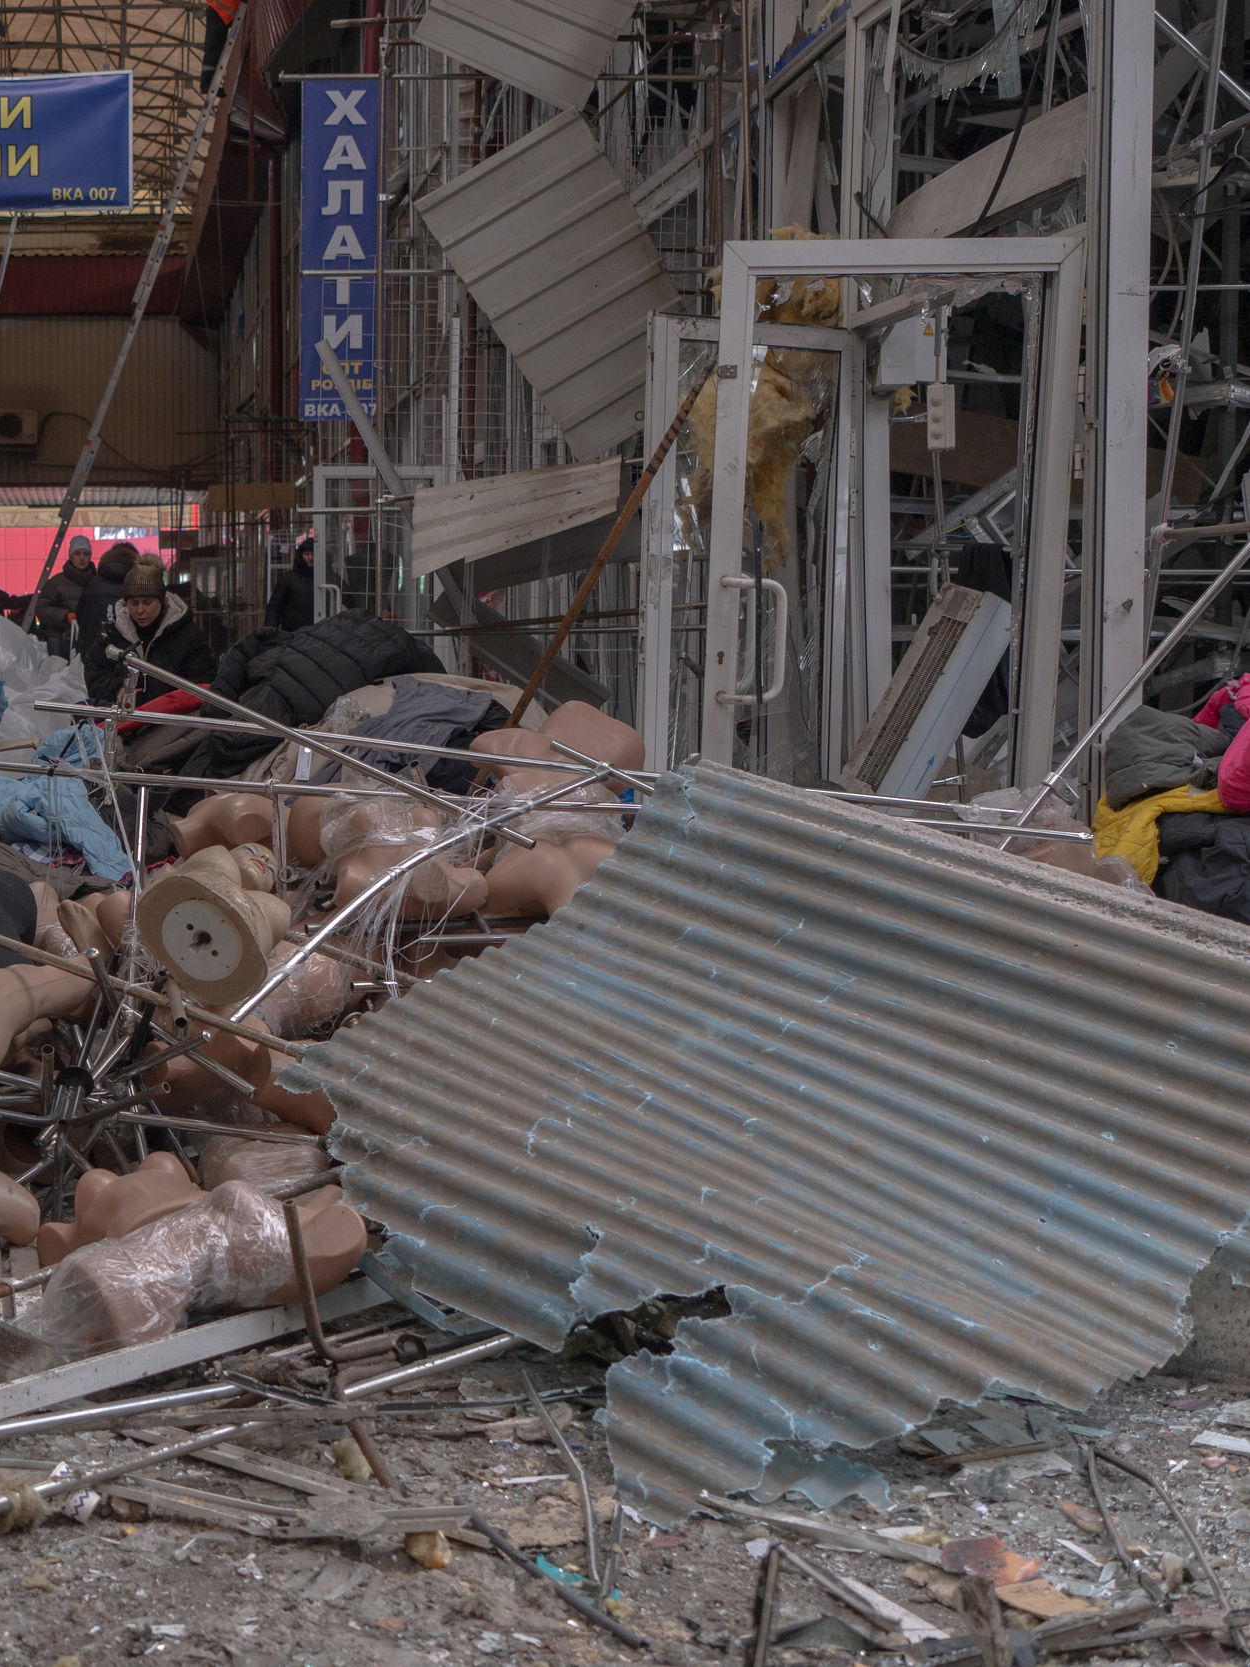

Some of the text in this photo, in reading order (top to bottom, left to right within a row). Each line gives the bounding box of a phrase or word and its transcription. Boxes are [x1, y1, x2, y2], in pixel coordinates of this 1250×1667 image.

[52, 187, 117, 201] ВКА 007
[321, 90, 367, 349] ХАЛАТИ
[304, 403, 341, 417] ВКА
